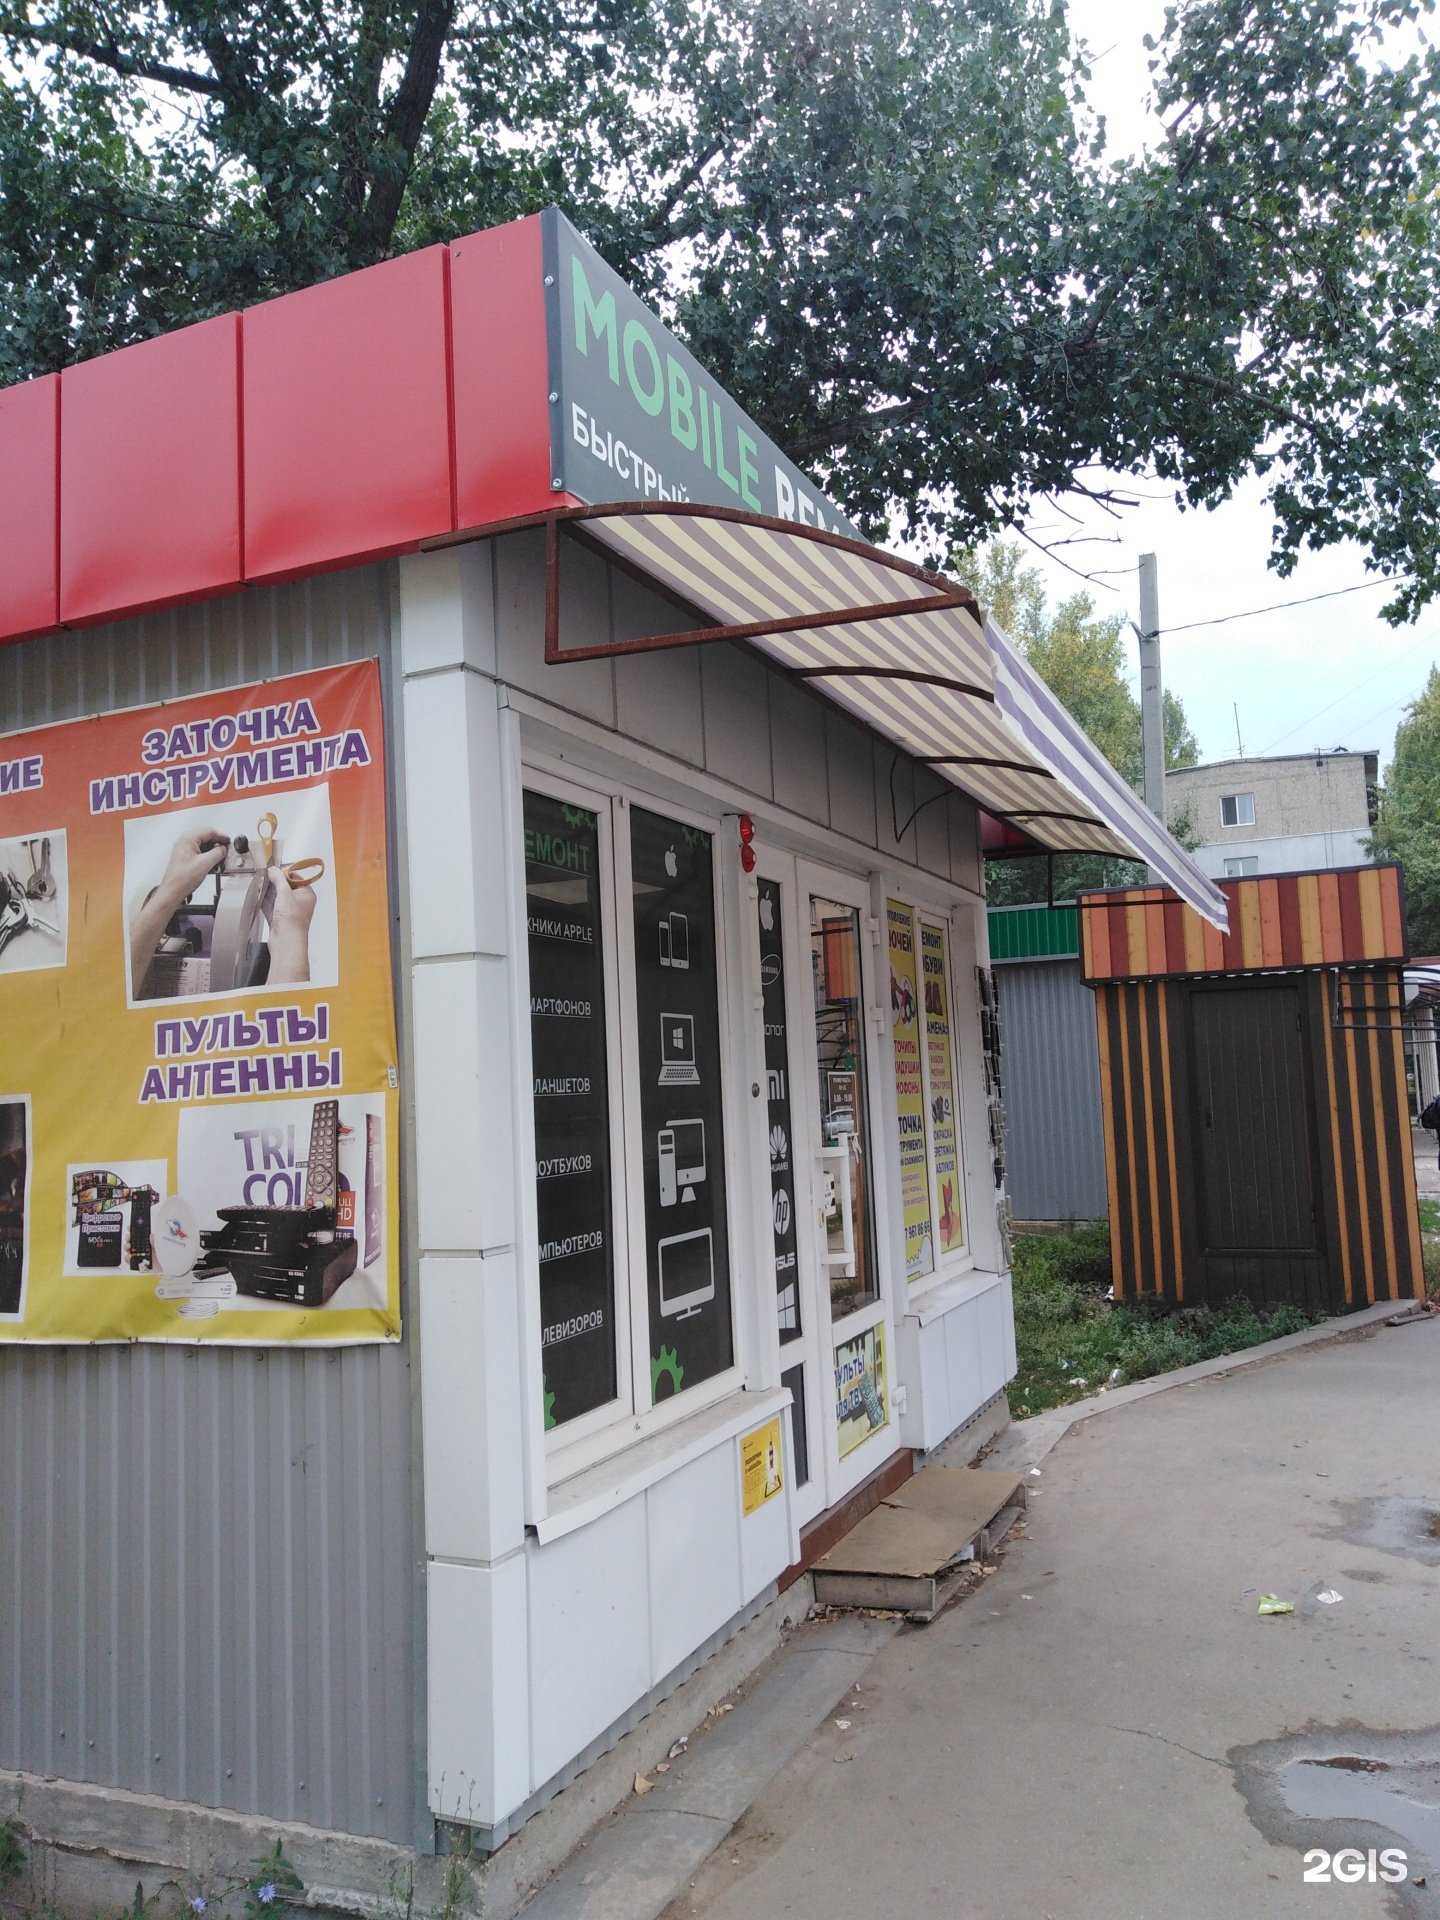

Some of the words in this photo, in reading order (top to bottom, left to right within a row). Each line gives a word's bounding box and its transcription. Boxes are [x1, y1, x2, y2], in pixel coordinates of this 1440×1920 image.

[572, 255, 762, 514] MOBILE
[142, 699, 321, 766] ЗАТОЧКА
[89, 729, 371, 816] ИНСТРУМЕНТА
[563, 924, 592, 941] APPLE
[154, 1003, 329, 1058] ПУЛЬТЫ
[138, 1048, 342, 1104] АНТЕННЫ
[234, 1124, 295, 1171] TRI
[537, 1155, 592, 1176] ОУТБУКОВ
[542, 1310, 603, 1345] ЛЕВИЗОРОВ
